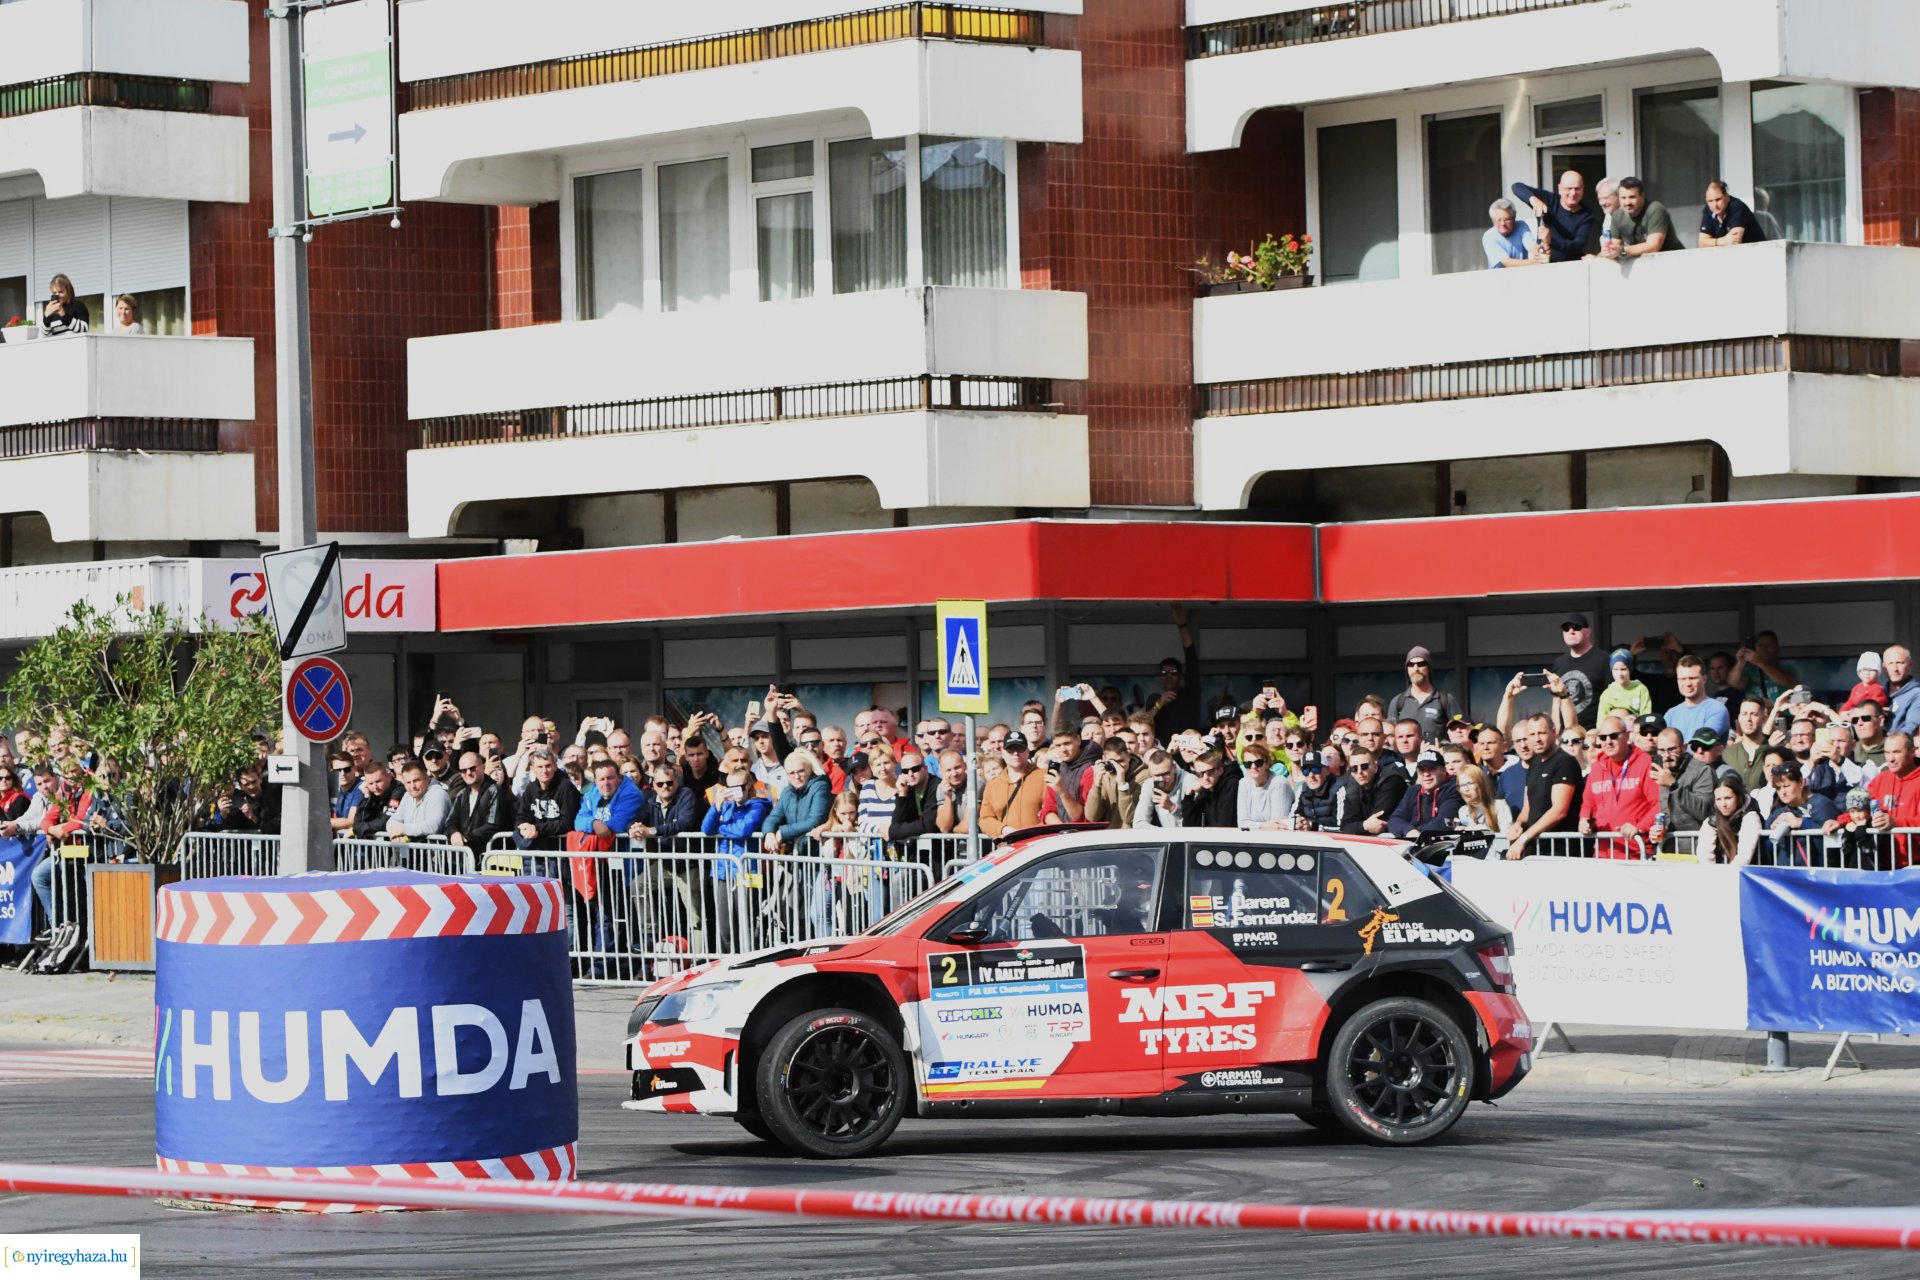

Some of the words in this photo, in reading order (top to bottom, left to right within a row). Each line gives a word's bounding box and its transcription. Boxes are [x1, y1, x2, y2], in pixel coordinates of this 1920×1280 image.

[1326, 878, 1346, 920] 2
[1232, 910, 1317, 925] Fernández
[1550, 901, 1672, 935] HUMDA
[1382, 922, 1411, 930] CUEVA
[1412, 922, 1424, 930] DE
[1243, 932, 1277, 942] PAGID
[1575, 944, 1616, 959] ROAD
[1624, 945, 1674, 960] SAFETY
[1810, 949, 1867, 967] HUMDA
[941, 957, 958, 984] 2
[995, 967, 1025, 982] RALLY
[1028, 961, 1075, 980] HUNGARY
[968, 987, 982, 997] FIA
[1000, 983, 1050, 994] Championship
[1811, 974, 1823, 990] A
[1827, 971, 1915, 993] BIZTONSÁG
[1027, 1002, 1083, 1017] HUMDA
[1118, 981, 1275, 1023] MRF
[1046, 1020, 1084, 1032] TRP
[1140, 1023, 1259, 1055] TYRES
[181, 998, 561, 1104] HUMDA
[648, 1040, 691, 1057] MRF
[963, 1058, 1042, 1069] RALLYE
[1216, 1070, 1262, 1080] FARMA10
[1262, 1077, 1284, 1085] SALUD
